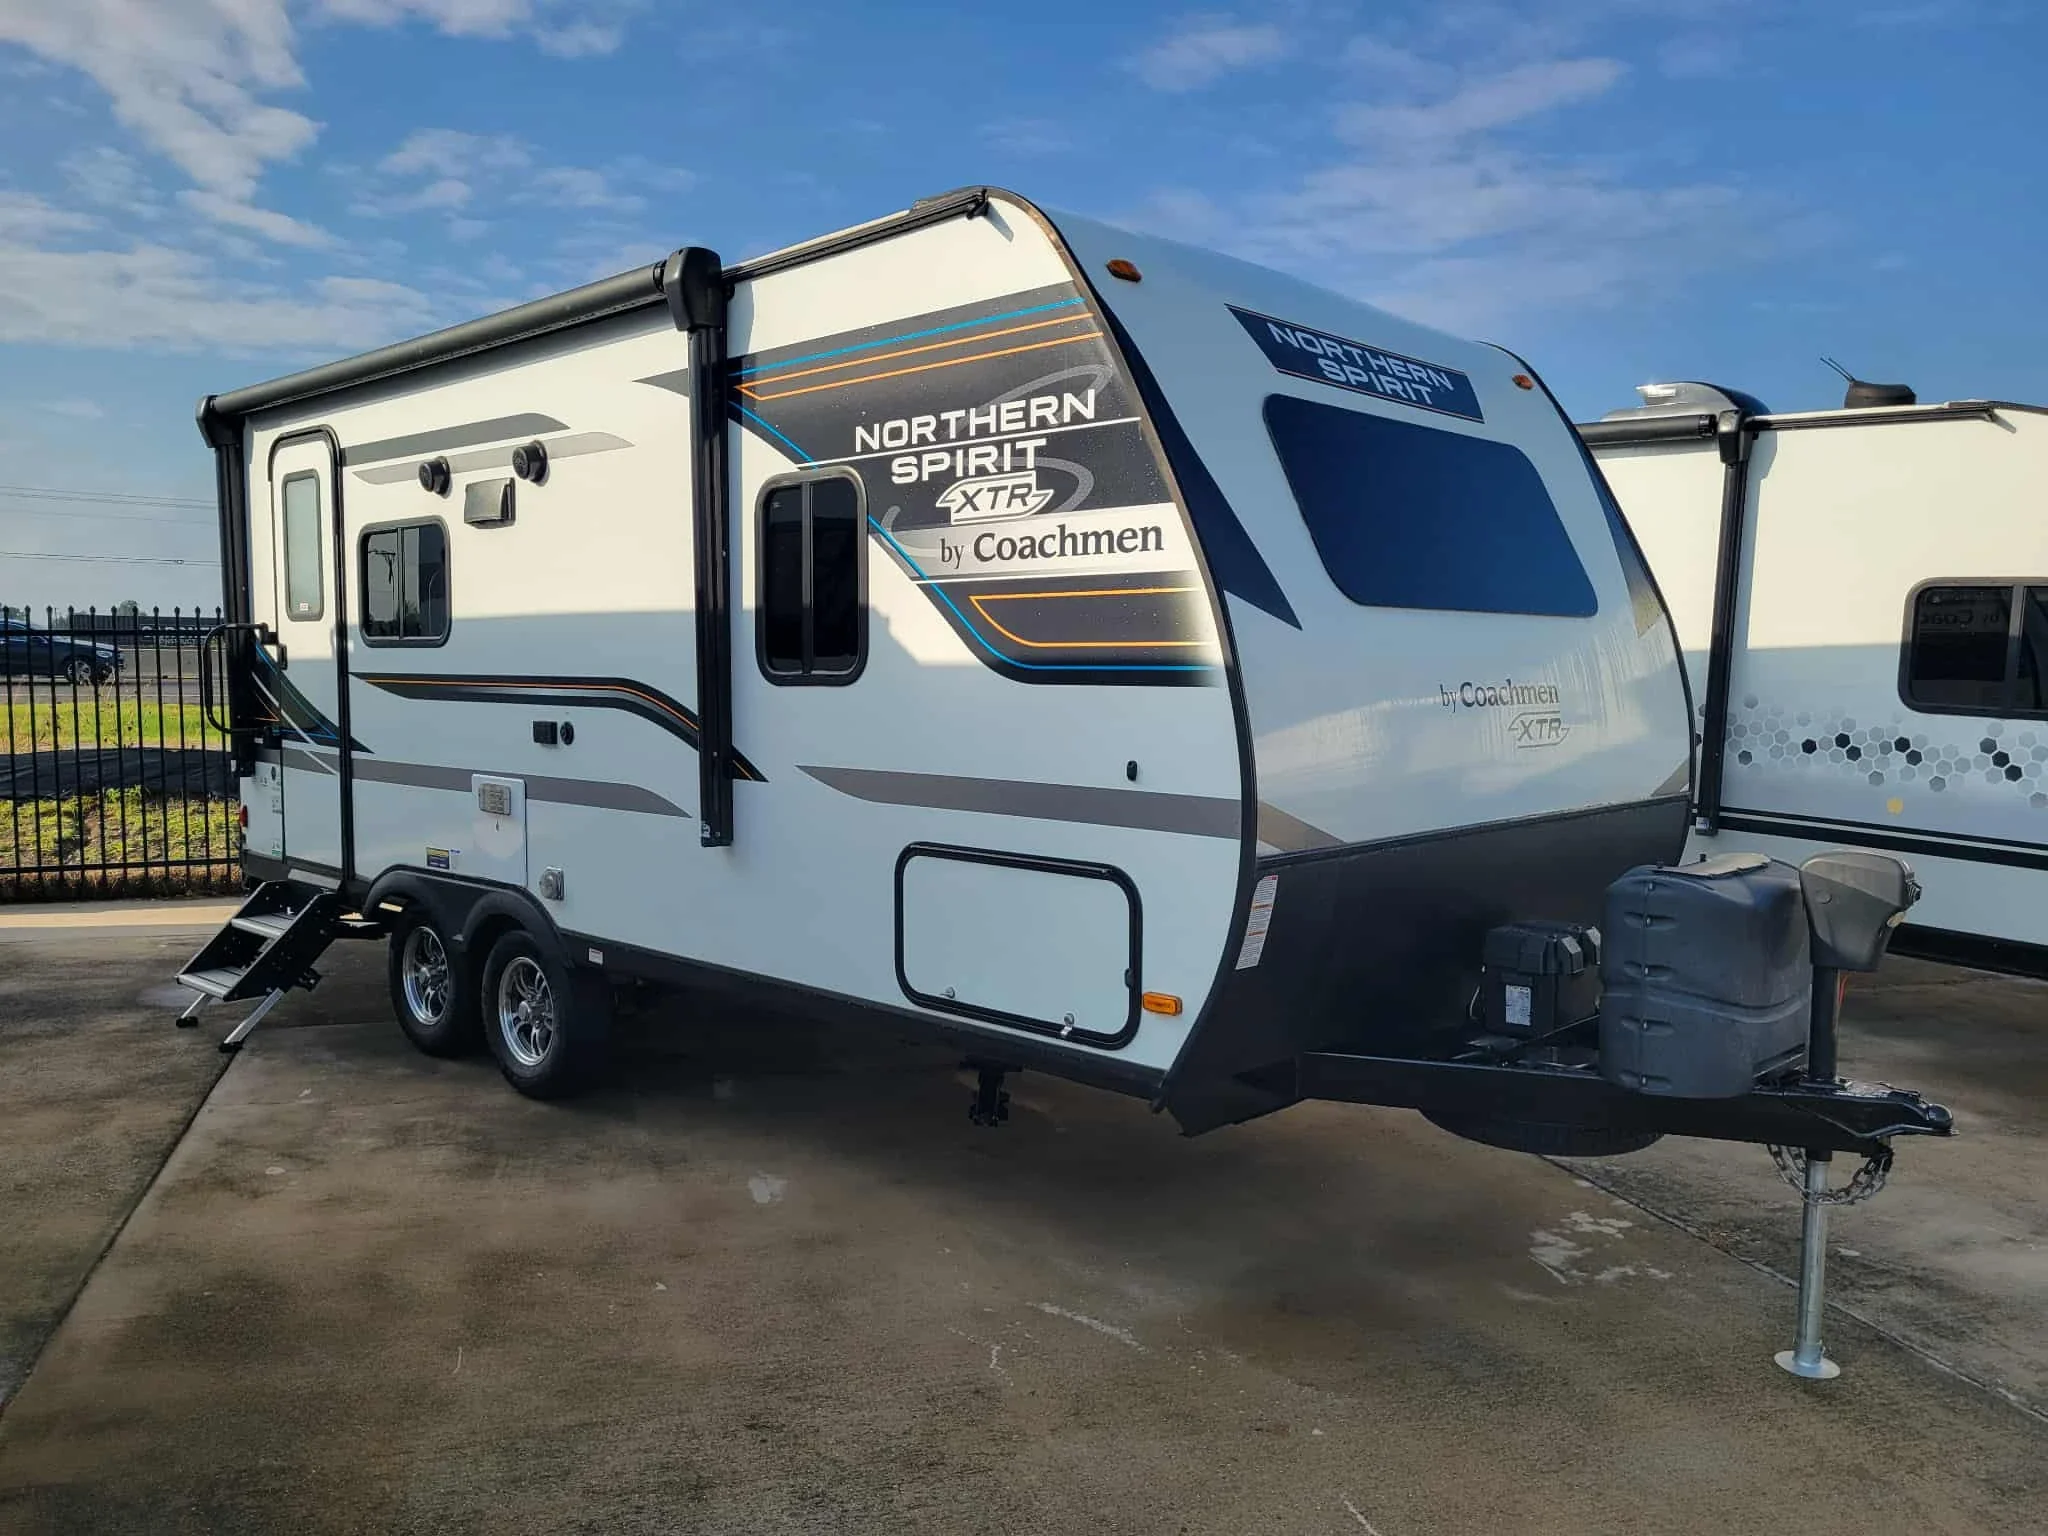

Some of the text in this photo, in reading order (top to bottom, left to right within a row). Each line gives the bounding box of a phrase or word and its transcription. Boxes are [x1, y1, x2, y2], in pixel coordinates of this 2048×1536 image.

[1267, 321, 1454, 392] NORTHERN
[1318, 357, 1433, 405] SPIRIT
[854, 388, 1096, 453] NORTHERN
[890, 439, 1048, 484] SPIRIT
[956, 485, 1033, 514] XTR
[940, 524, 1165, 569] by Coachmen
[1440, 678, 1559, 712] by Coachmen
[1517, 717, 1562, 742] XTR
